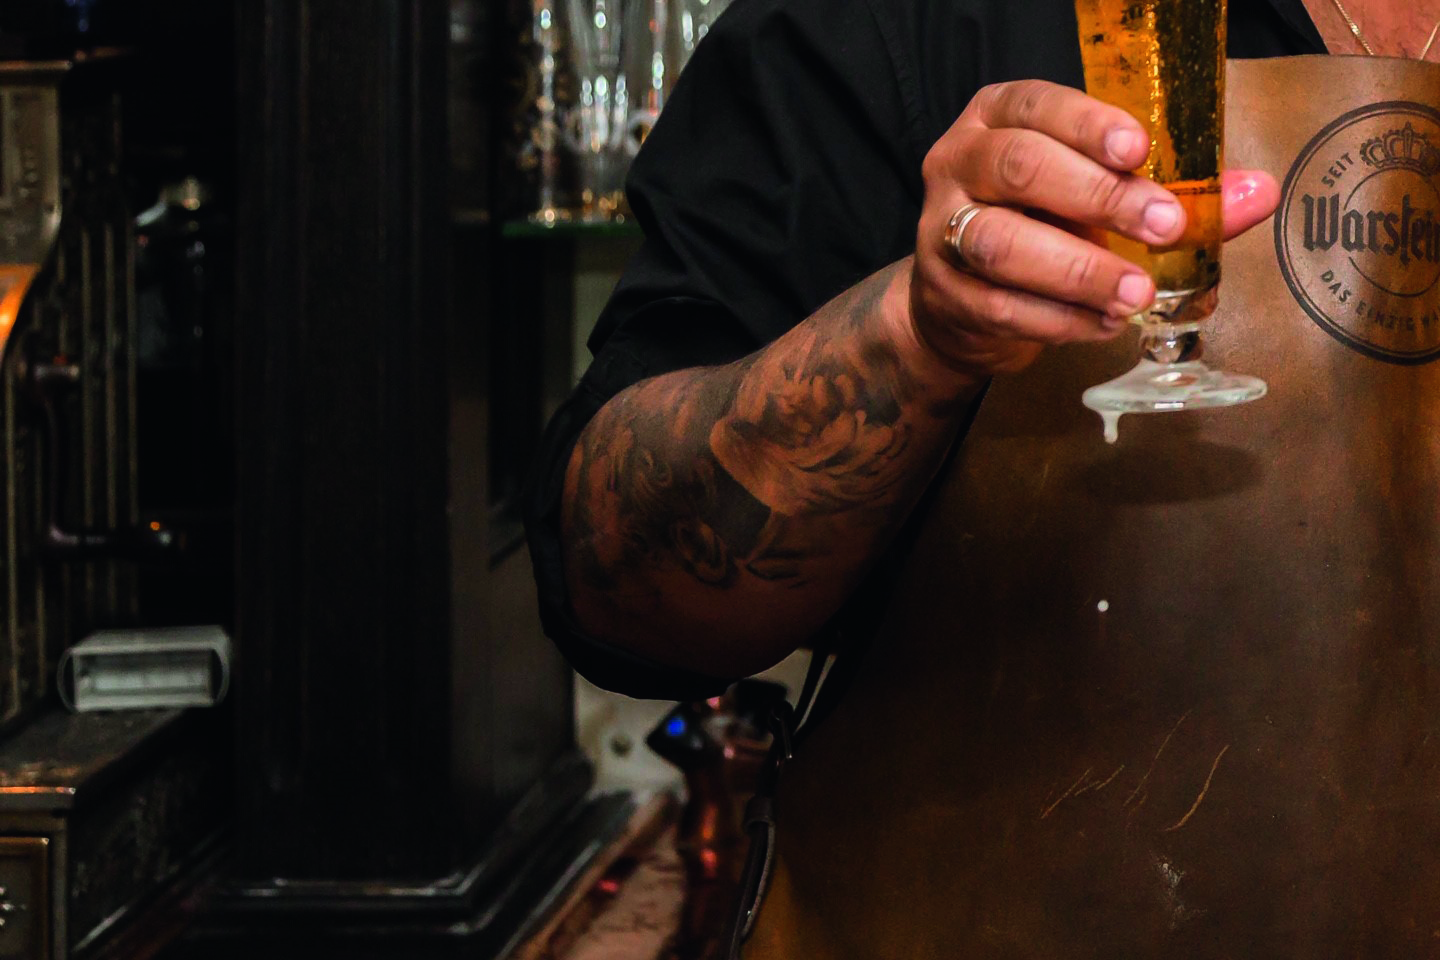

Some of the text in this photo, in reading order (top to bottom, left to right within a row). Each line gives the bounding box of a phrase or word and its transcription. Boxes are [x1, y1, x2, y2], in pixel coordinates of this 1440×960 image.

[1322, 152, 1355, 188] SEIT
[1320, 270, 1353, 304] DAS
[1356, 301, 1415, 332] EINZIG
